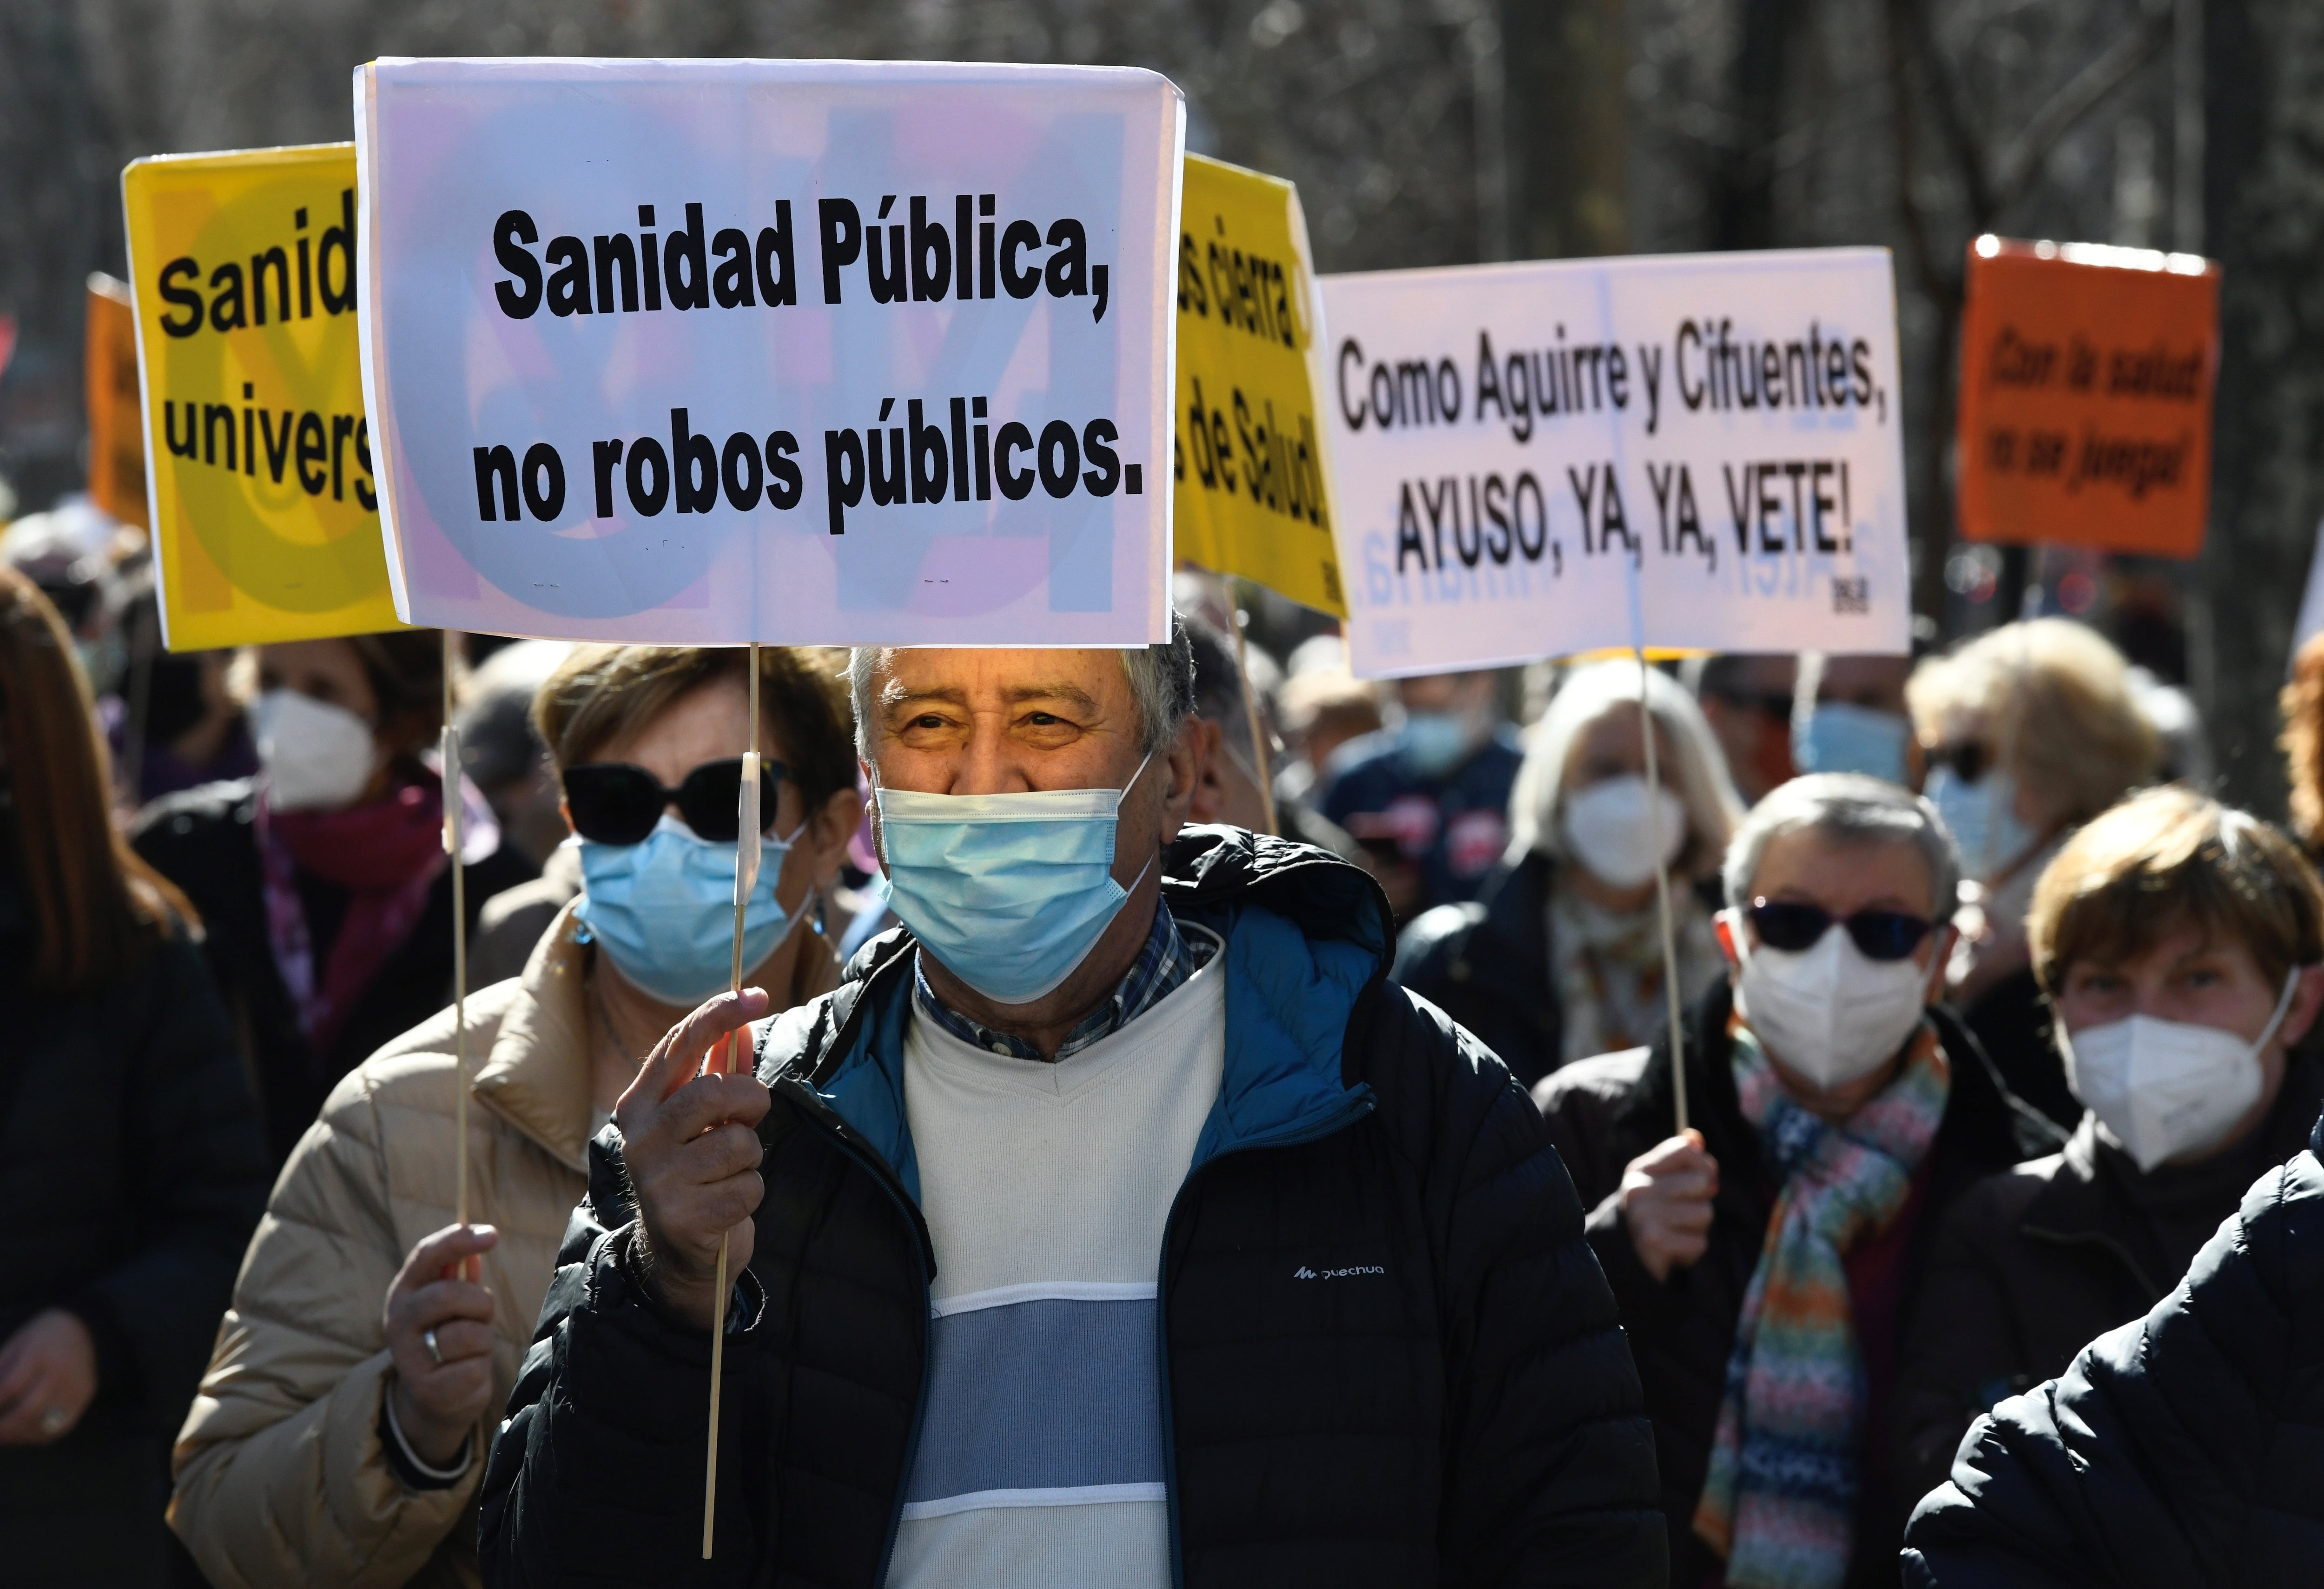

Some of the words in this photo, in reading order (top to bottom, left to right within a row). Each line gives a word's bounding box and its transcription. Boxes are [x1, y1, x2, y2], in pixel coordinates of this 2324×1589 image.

[493, 199, 797, 320] Sanidad
[818, 194, 1109, 324] Pública,
[1208, 215, 1295, 350] cierra
[1190, 375, 1236, 495] de
[1338, 338, 1462, 432] Como
[1476, 321, 1629, 445] Aguirre
[1639, 346, 1661, 436] y
[1676, 317, 1886, 424] Cifuentes,
[473, 443, 566, 522] no
[593, 408, 803, 518] robos
[825, 396, 1142, 535] públicos.
[1397, 470, 1561, 576] AYUSO,
[1568, 463, 1643, 568] YA,
[1646, 463, 1717, 572] YA,
[1723, 461, 1853, 555] VETE!
